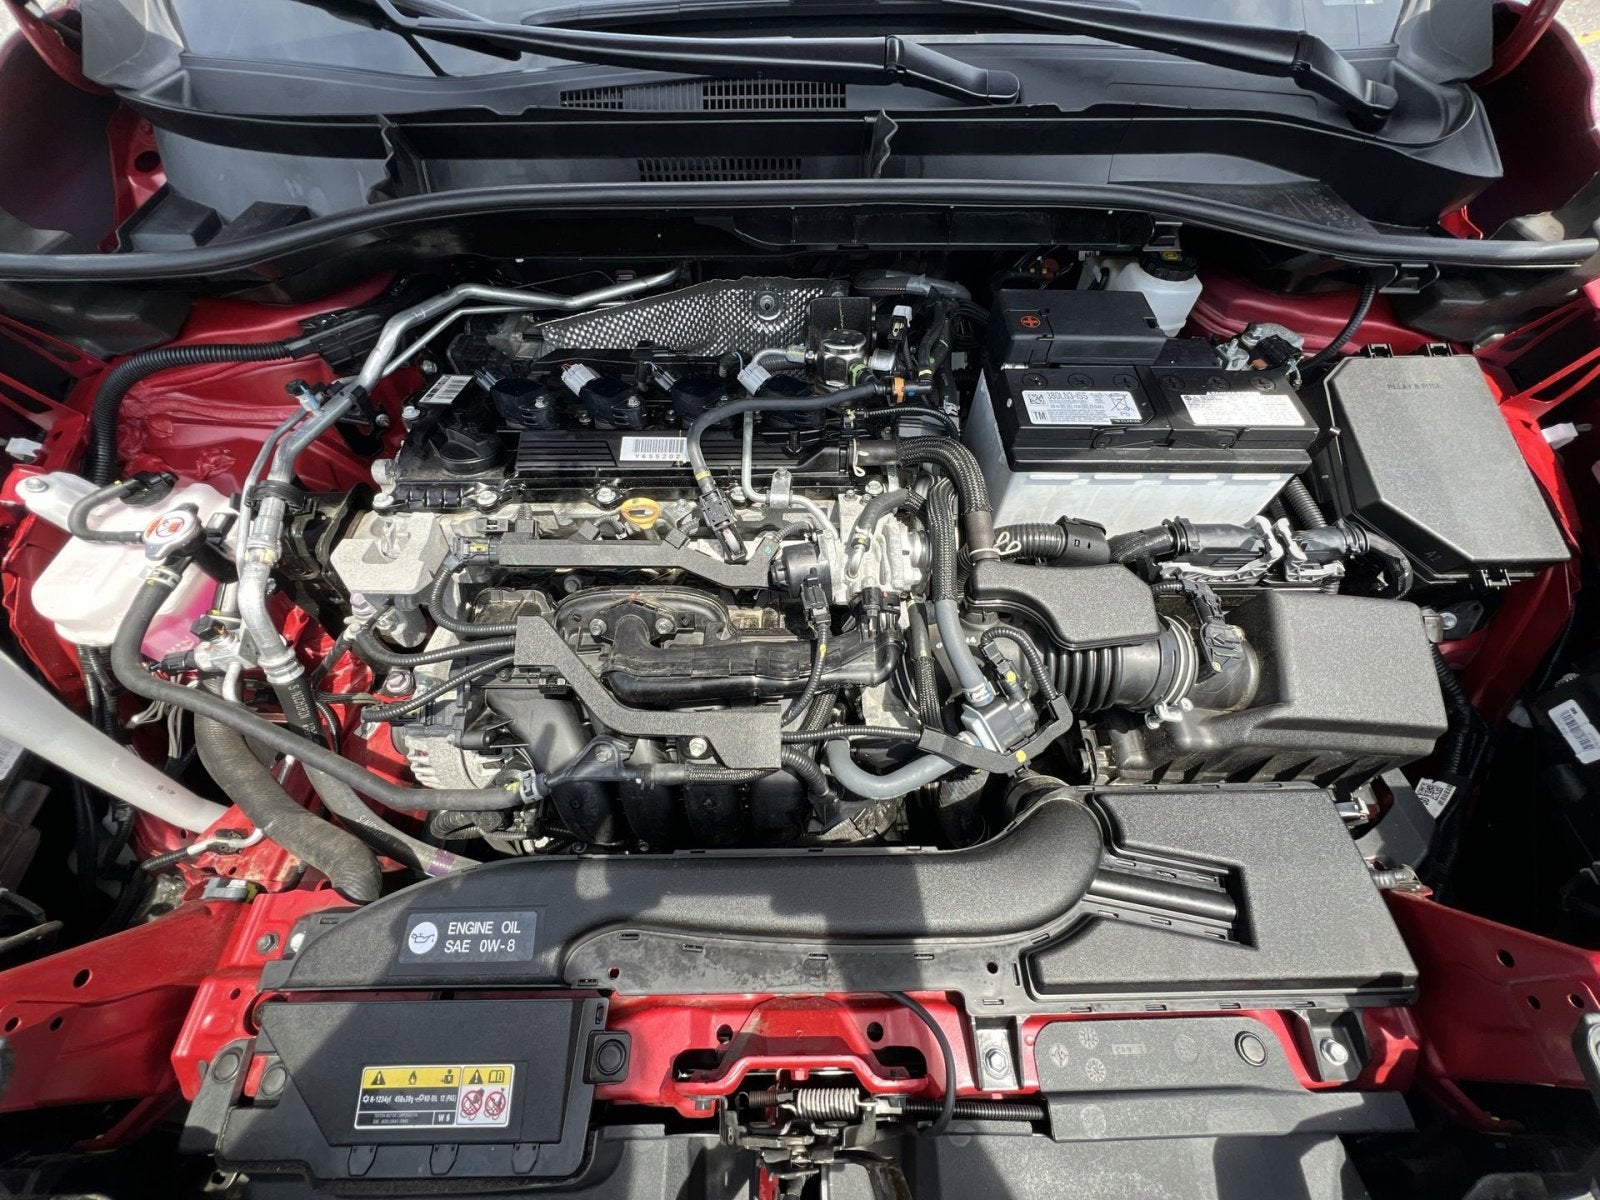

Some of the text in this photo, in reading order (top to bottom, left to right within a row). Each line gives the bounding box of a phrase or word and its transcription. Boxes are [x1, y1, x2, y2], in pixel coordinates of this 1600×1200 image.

[1034, 411, 1047, 420] TM
[447, 920, 521, 935] ENGINE OIL
[444, 938, 516, 953] SAE 0W-8
